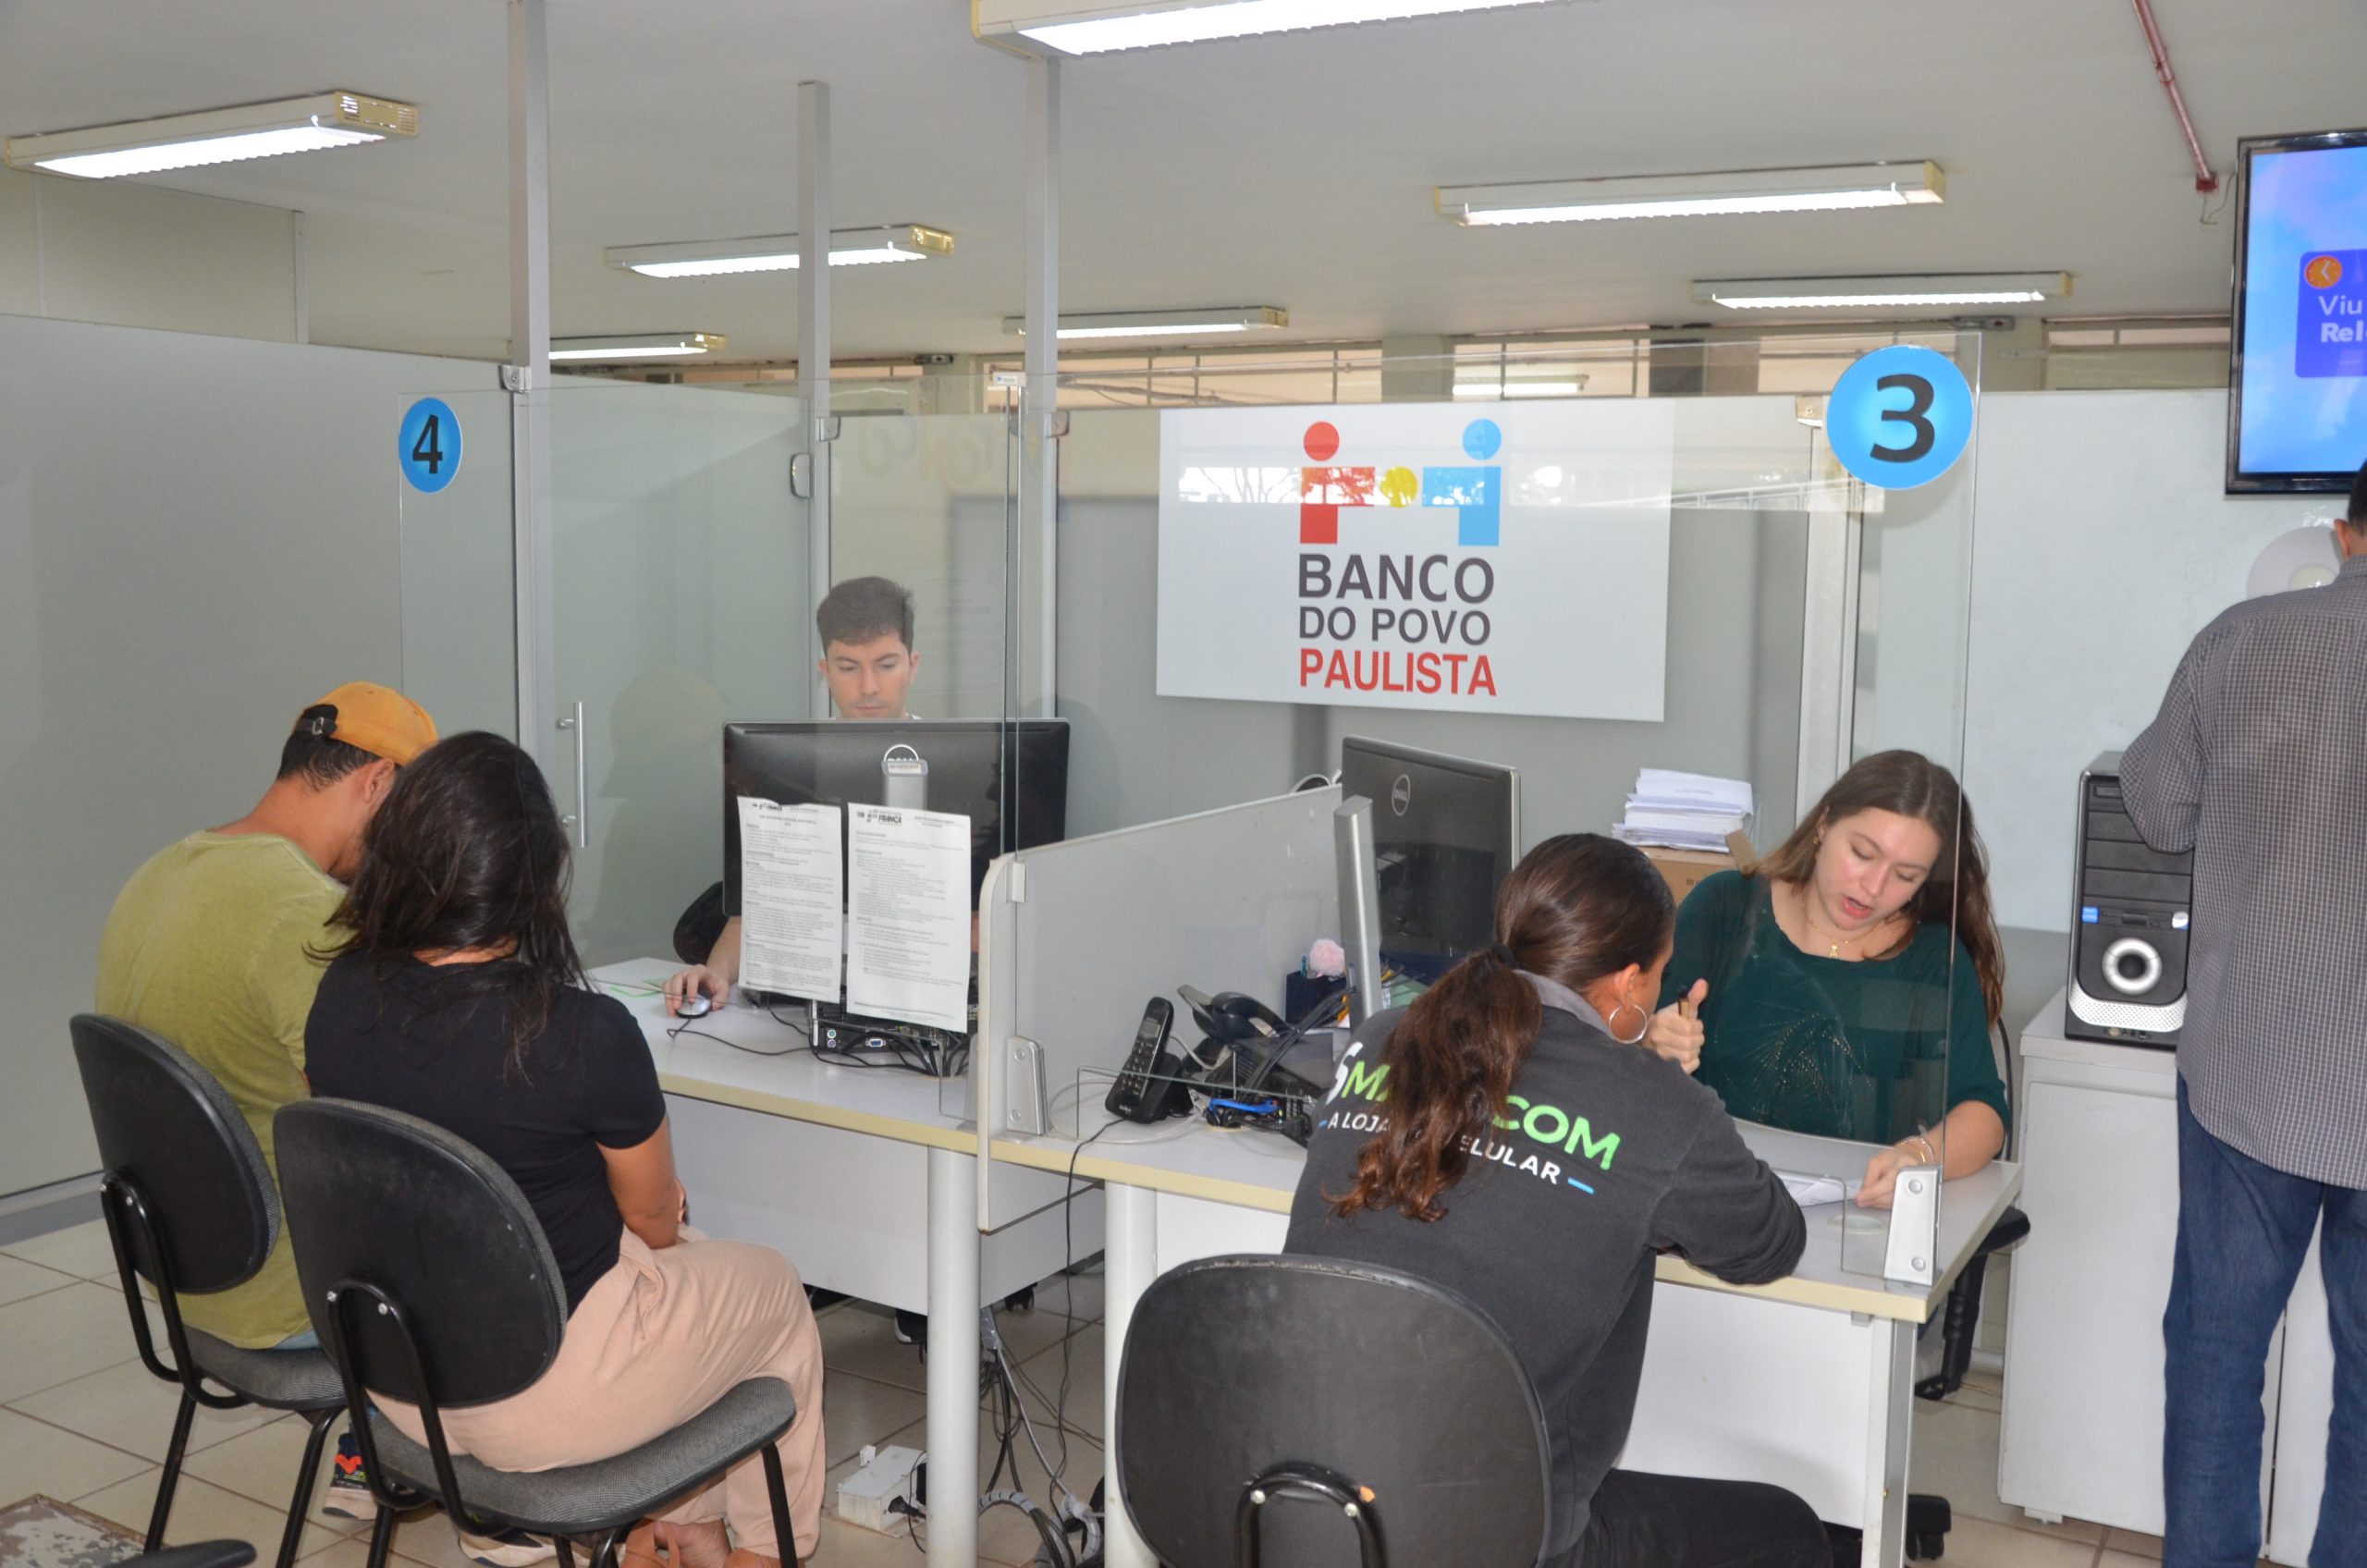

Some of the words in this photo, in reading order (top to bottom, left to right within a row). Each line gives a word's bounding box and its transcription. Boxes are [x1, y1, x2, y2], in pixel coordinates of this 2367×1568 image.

[2318, 294, 2363, 317] Viu
[2320, 320, 2367, 343] Rel
[412, 413, 444, 474] 4
[1870, 373, 1936, 464] 3
[1298, 552, 1495, 605] BANCO
[1299, 606, 1356, 641] DO
[1371, 607, 1491, 646] POVO
[1300, 647, 1497, 697] PAULISTA
[1325, 1041, 1621, 1170] SMCOM
[1327, 1111, 1340, 1130] A
[1459, 1134, 1562, 1185] ELULAR
